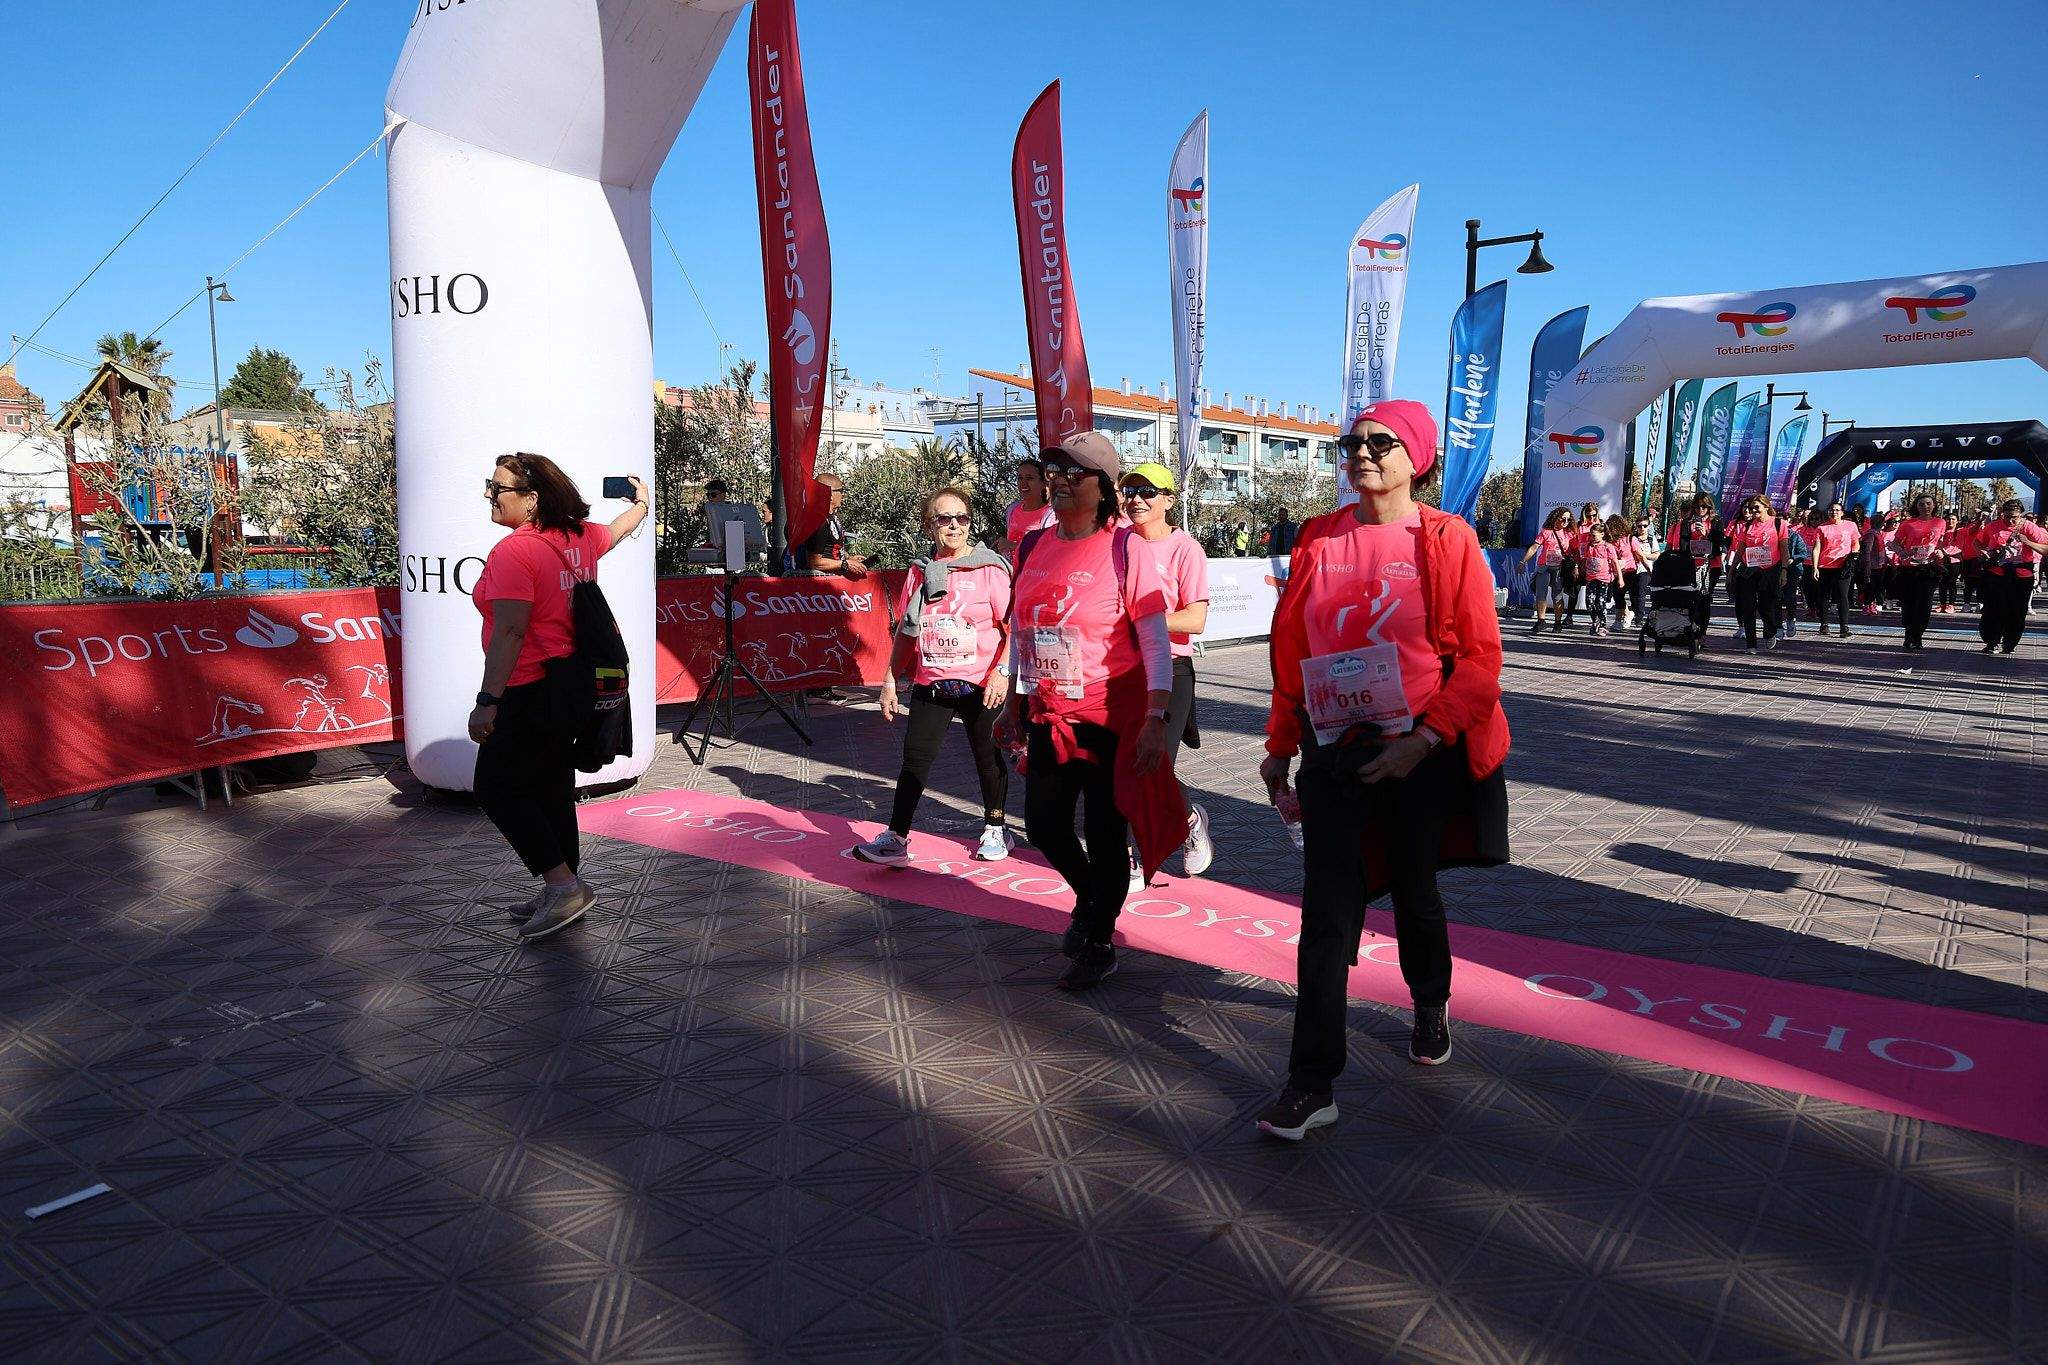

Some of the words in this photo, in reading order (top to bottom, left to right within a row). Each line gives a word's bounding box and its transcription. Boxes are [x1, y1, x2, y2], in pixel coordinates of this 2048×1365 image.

[766, 44, 804, 299] Santander
[1355, 264, 1403, 272] TotalEnergies
[1715, 342, 1796, 356] TotalEnergies
[1882, 328, 1974, 344] TotalEnergies
[1367, 300, 1391, 399] LasCarreras
[1701, 406, 1730, 496] Batiste
[1872, 435, 2003, 449] VOLVO
[1547, 460, 1603, 469] TotalEnergies
[656, 598, 709, 624] orts
[746, 591, 873, 616] Santander
[34, 624, 228, 677] Sports
[301, 607, 402, 644] Sant
[938, 637, 959, 647] 016
[1035, 658, 1059, 670] 016
[1337, 689, 1374, 708] 016
[625, 804, 807, 843] OYSHO
[840, 846, 1071, 895] SHO
[1523, 973, 1975, 1073] OYSHO
